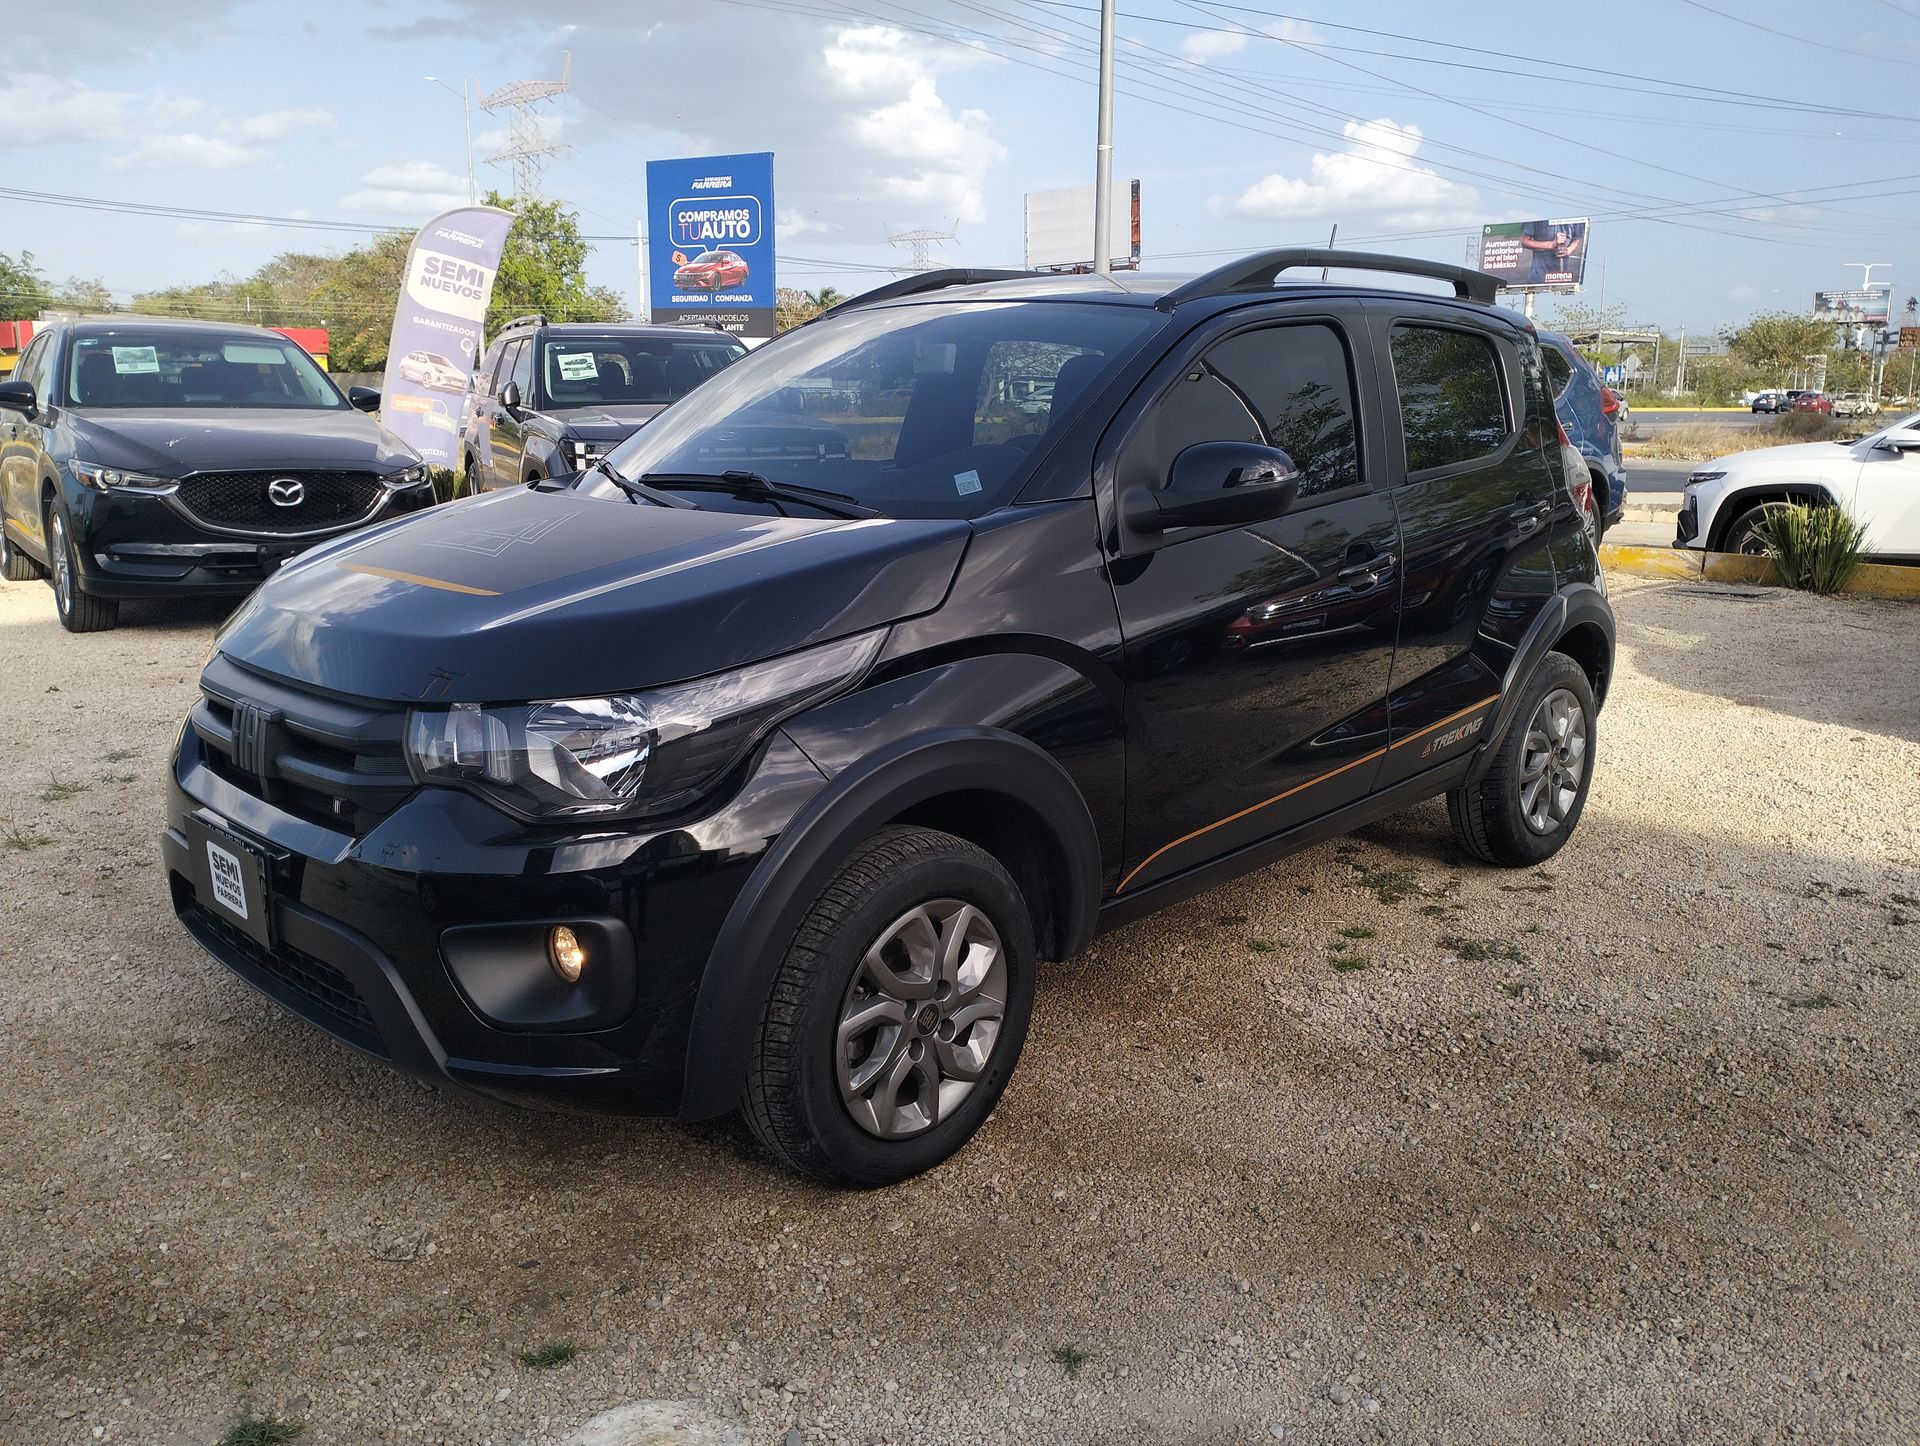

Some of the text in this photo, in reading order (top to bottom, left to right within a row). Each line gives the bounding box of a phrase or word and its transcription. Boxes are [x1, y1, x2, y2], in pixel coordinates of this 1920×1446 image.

[691, 180, 732, 189] FARRERA
[678, 209, 749, 223] COMPRAMOS
[435, 230, 482, 249] FARRERA
[1485, 240, 1520, 248] Aumentar
[424, 256, 485, 289] SEMI
[1493, 260, 1516, 269] México
[1545, 272, 1572, 280] morena
[420, 275, 482, 301] NUEVOS
[715, 294, 753, 302] CONFIANZA
[718, 314, 749, 322] MODELOS
[412, 316, 476, 337] GARANTIZADOS
[212, 851, 240, 884] SEMI
[214, 871, 242, 897] NUEVOS
[217, 886, 243, 910] FARRERA
